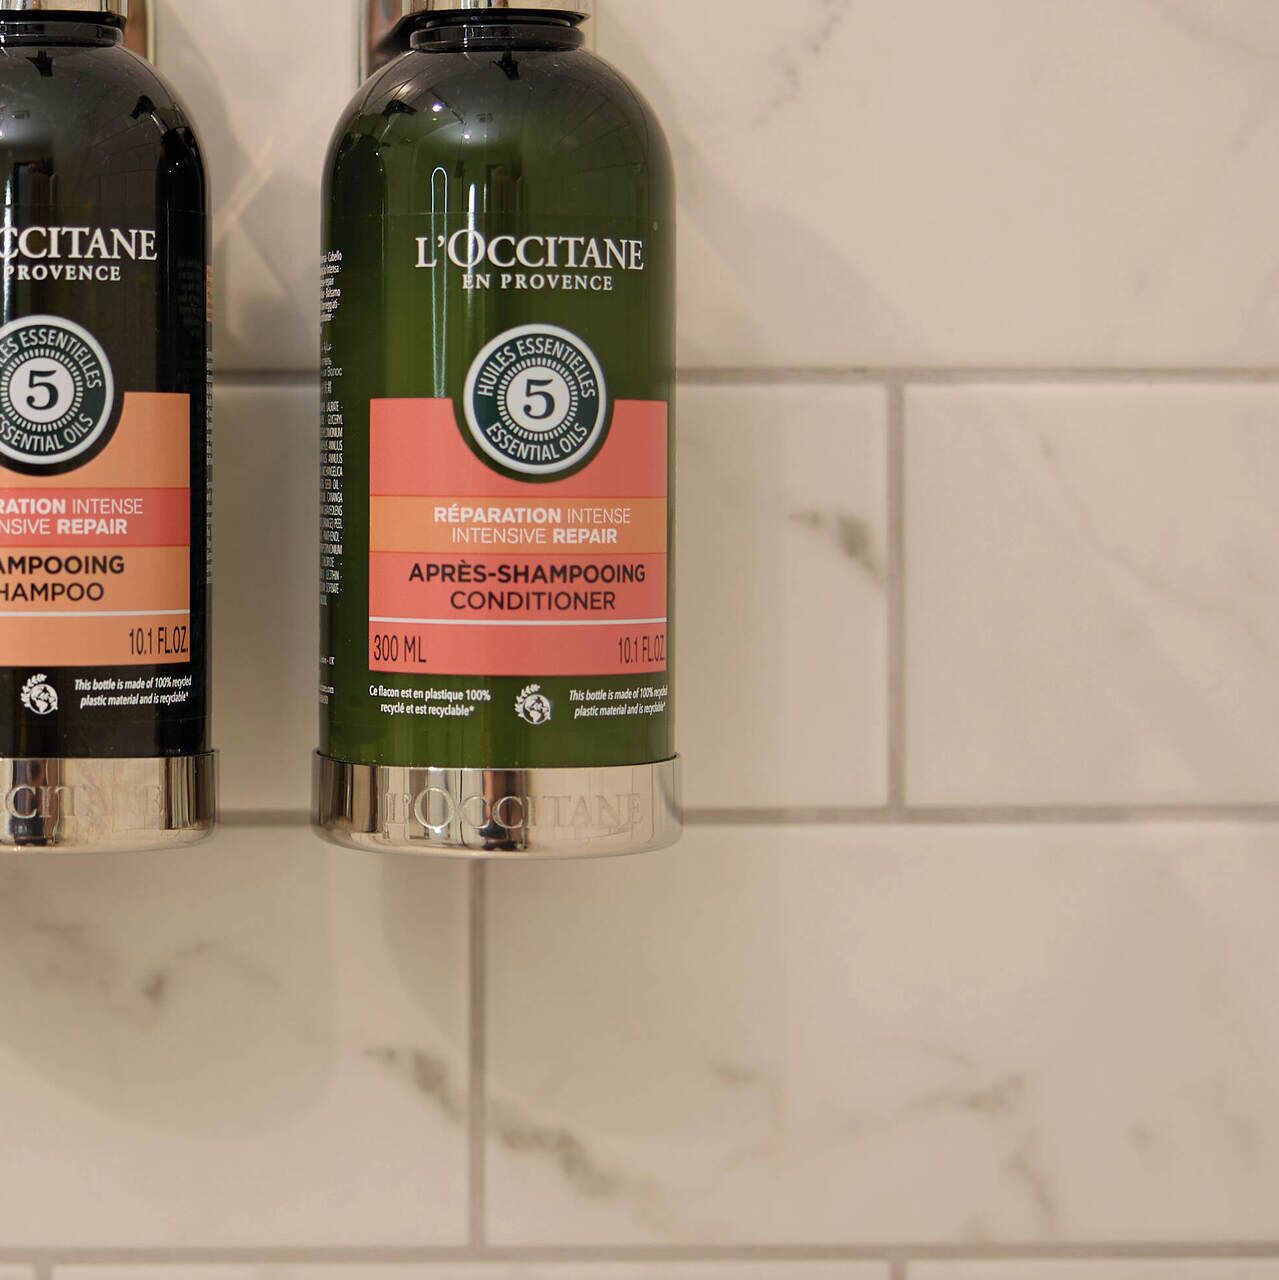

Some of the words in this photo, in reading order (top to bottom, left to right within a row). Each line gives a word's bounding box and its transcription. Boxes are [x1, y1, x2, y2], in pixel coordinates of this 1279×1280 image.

[415, 228, 645, 271] L'OCCITANE
[4, 265, 121, 281] PROVENCE
[462, 274, 490, 290] EN
[501, 274, 613, 291] PROVENCE
[19, 328, 102, 390] ESSENTIELLES
[477, 346, 516, 397] HUILES
[516, 337, 596, 399] ESSENTIELLES
[25, 370, 59, 411] 5
[522, 379, 556, 420] 5
[65, 412, 94, 444] OILS
[486, 422, 560, 462] ESSENTIAL
[560, 422, 588, 454] OILS
[72, 498, 144, 515] INTENSE
[433, 503, 561, 524] RÉPARATION
[567, 507, 631, 524] INTENSE
[57, 519, 128, 535] REPAIR
[452, 527, 547, 544] INTENSIVE
[552, 527, 617, 544] REPAIR
[408, 559, 646, 584] APRÈS-SHAMPOOING
[450, 591, 616, 611] CONDITIONER
[129, 627, 152, 655] 10.1
[373, 634, 399, 662] 300
[404, 635, 427, 663] ML
[618, 636, 638, 664] 10.1
[74, 679, 91, 691] This
[92, 678, 116, 690] bottle
[117, 678, 124, 690] is
[124, 677, 145, 689] made
[146, 676, 154, 688] of
[155, 676, 172, 688] 100%
[369, 685, 378, 696] Ce
[379, 684, 399, 697] flacon
[400, 688, 412, 698] est
[413, 689, 424, 699] en
[425, 687, 464, 702] plastique
[465, 689, 491, 701] 100%
[569, 689, 585, 701] This
[585, 688, 607, 701] bottle
[607, 689, 614, 700] is
[614, 688, 632, 699] made
[632, 687, 640, 699] of
[640, 686, 654, 698] 100%
[79, 694, 107, 709] plastic
[107, 693, 139, 706] material
[139, 692, 153, 704] and
[153, 693, 159, 704] is
[380, 701, 405, 715] recyclé
[405, 704, 414, 714] et
[415, 704, 427, 715] est
[574, 705, 599, 719] plastic
[599, 703, 627, 716] material
[627, 702, 639, 714] and
[638, 703, 644, 714] is
